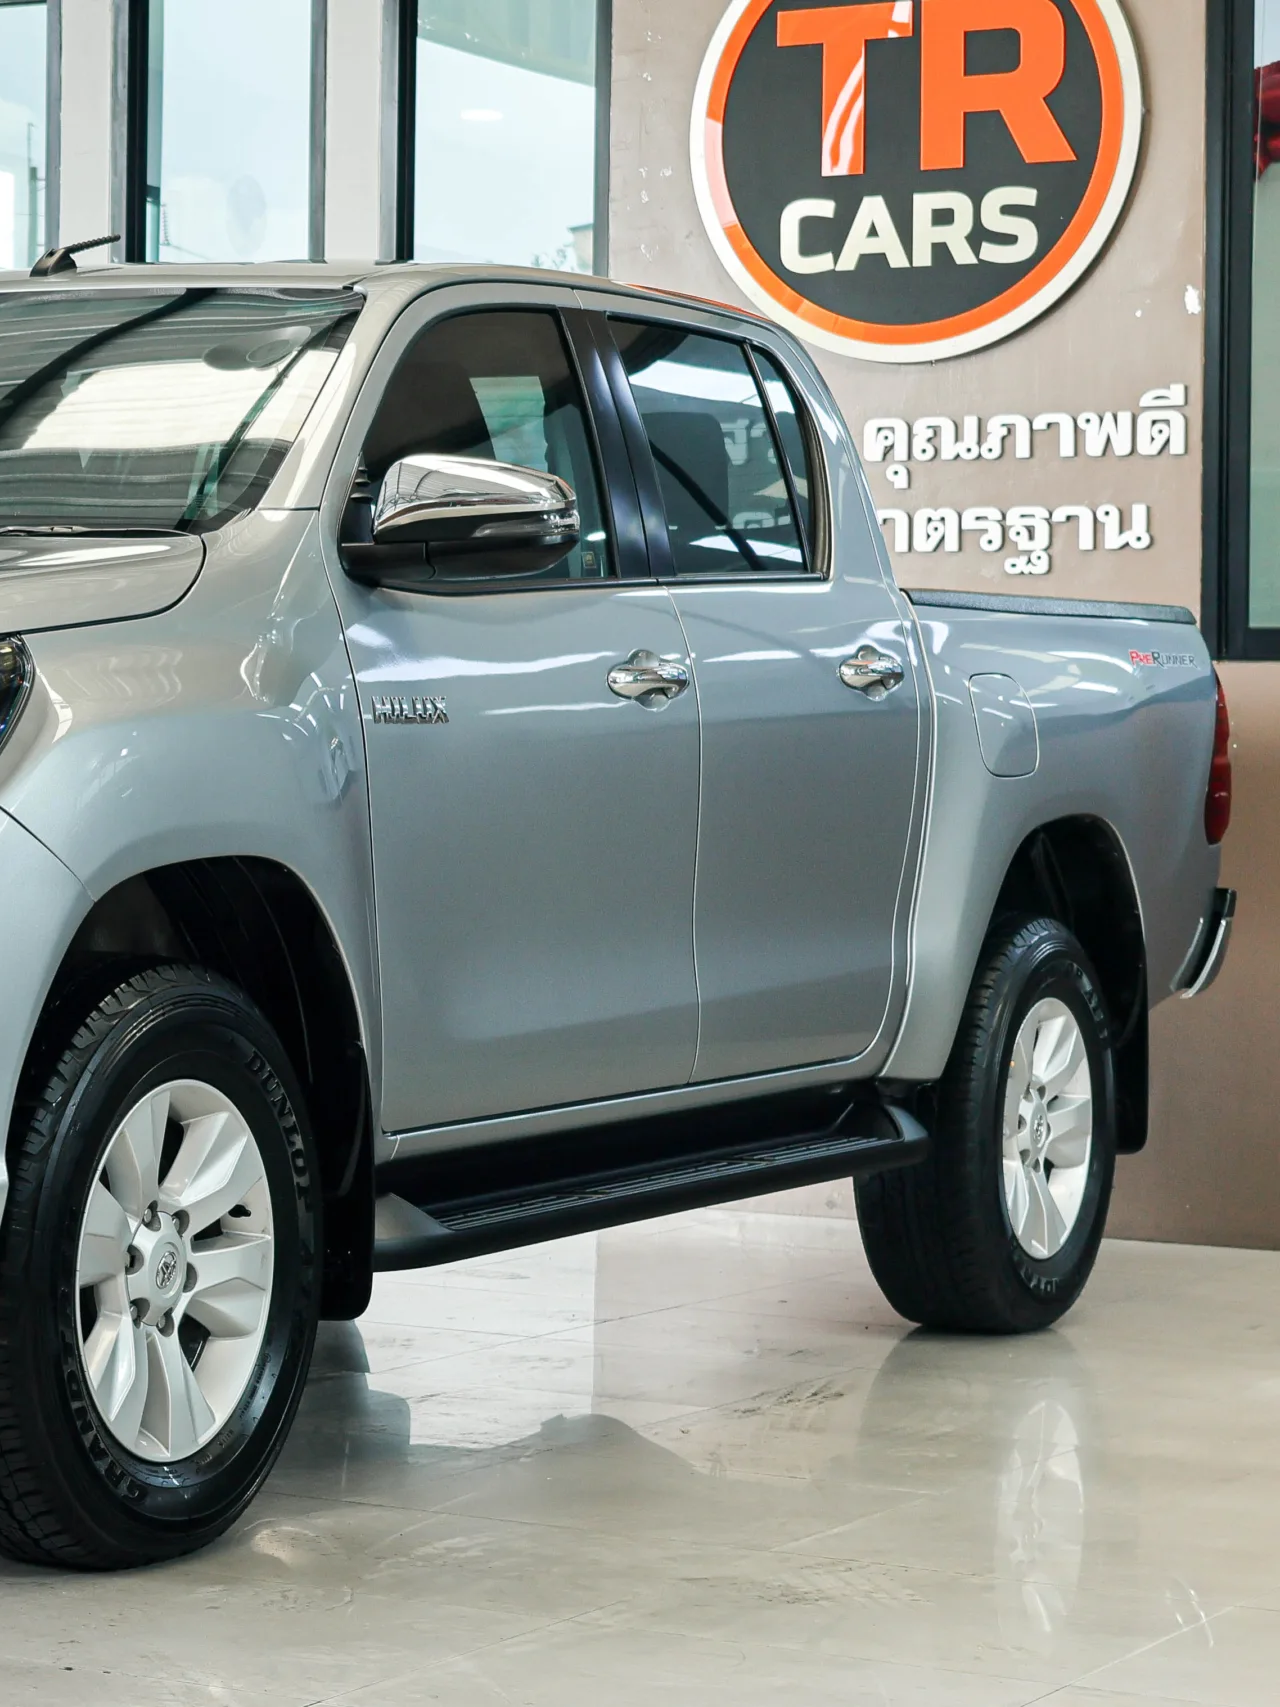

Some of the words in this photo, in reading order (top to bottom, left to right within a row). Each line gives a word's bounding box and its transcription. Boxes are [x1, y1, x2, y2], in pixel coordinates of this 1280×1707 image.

[776, 0, 1077, 178] TR
[779, 186, 1039, 275] CARS
[863, 384, 1188, 489] คุณภาพดี
[877, 503, 1152, 574] าตรฐาน
[371, 696, 449, 724] HILUX
